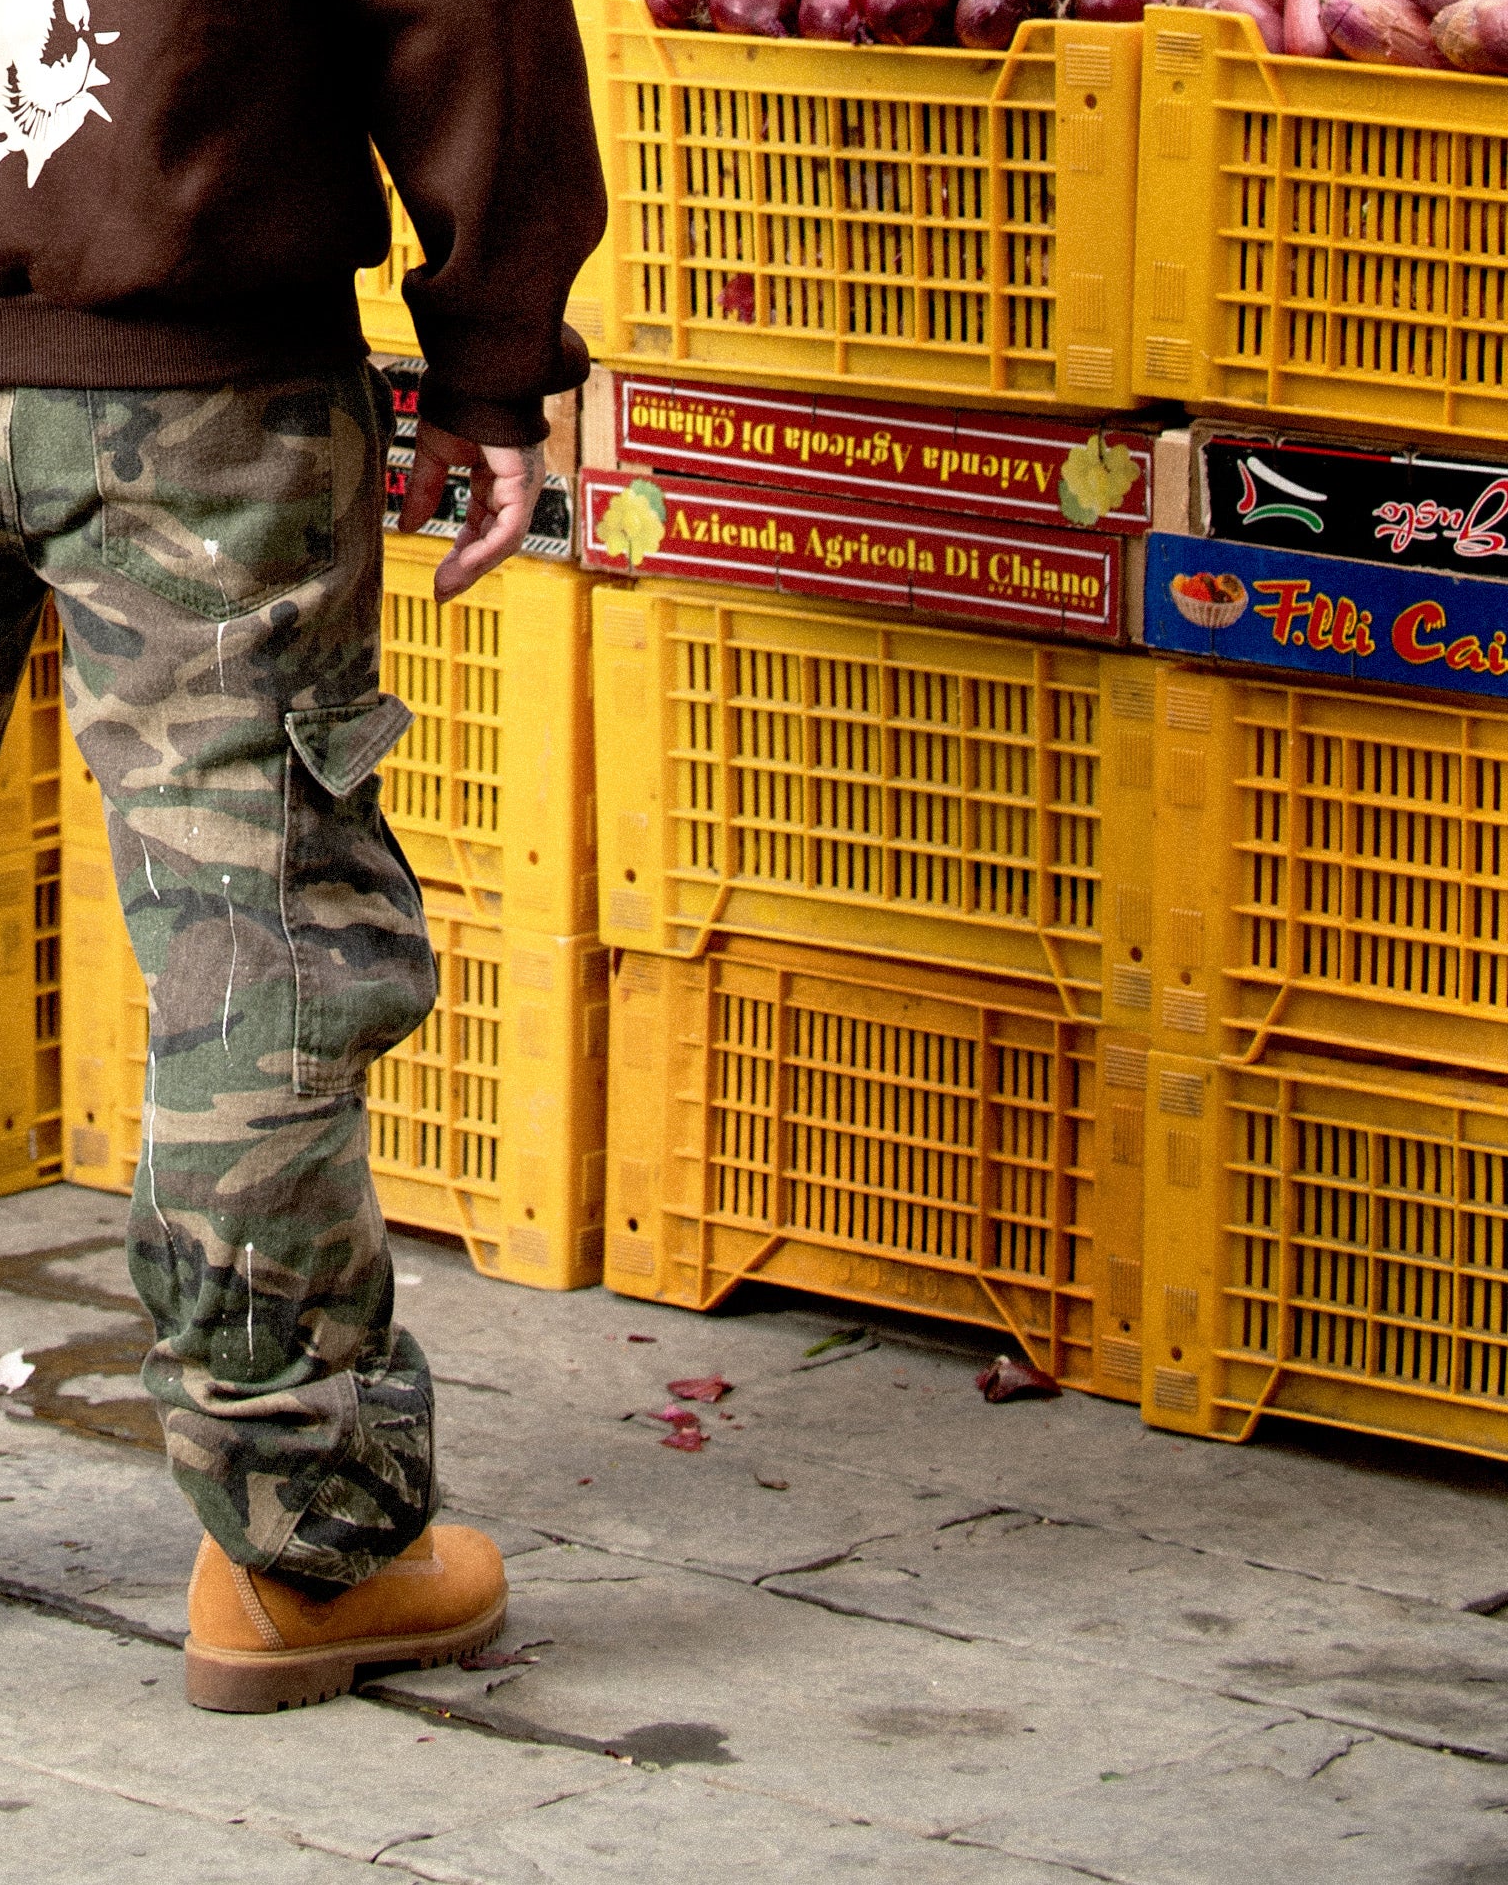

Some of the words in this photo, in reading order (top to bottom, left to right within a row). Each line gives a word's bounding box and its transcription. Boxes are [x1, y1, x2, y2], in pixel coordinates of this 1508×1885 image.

[632, 405, 736, 449] Chiano
[741, 421, 776, 455] Di
[783, 425, 913, 474] Agricola
[921, 446, 1054, 492] Azienda
[1372, 479, 1508, 557] Gusto
[670, 509, 796, 555] Azienda
[803, 526, 936, 574] Agricola
[944, 546, 980, 580] Di
[987, 552, 1100, 597] Chiano
[1253, 580, 1375, 656] F.lli
